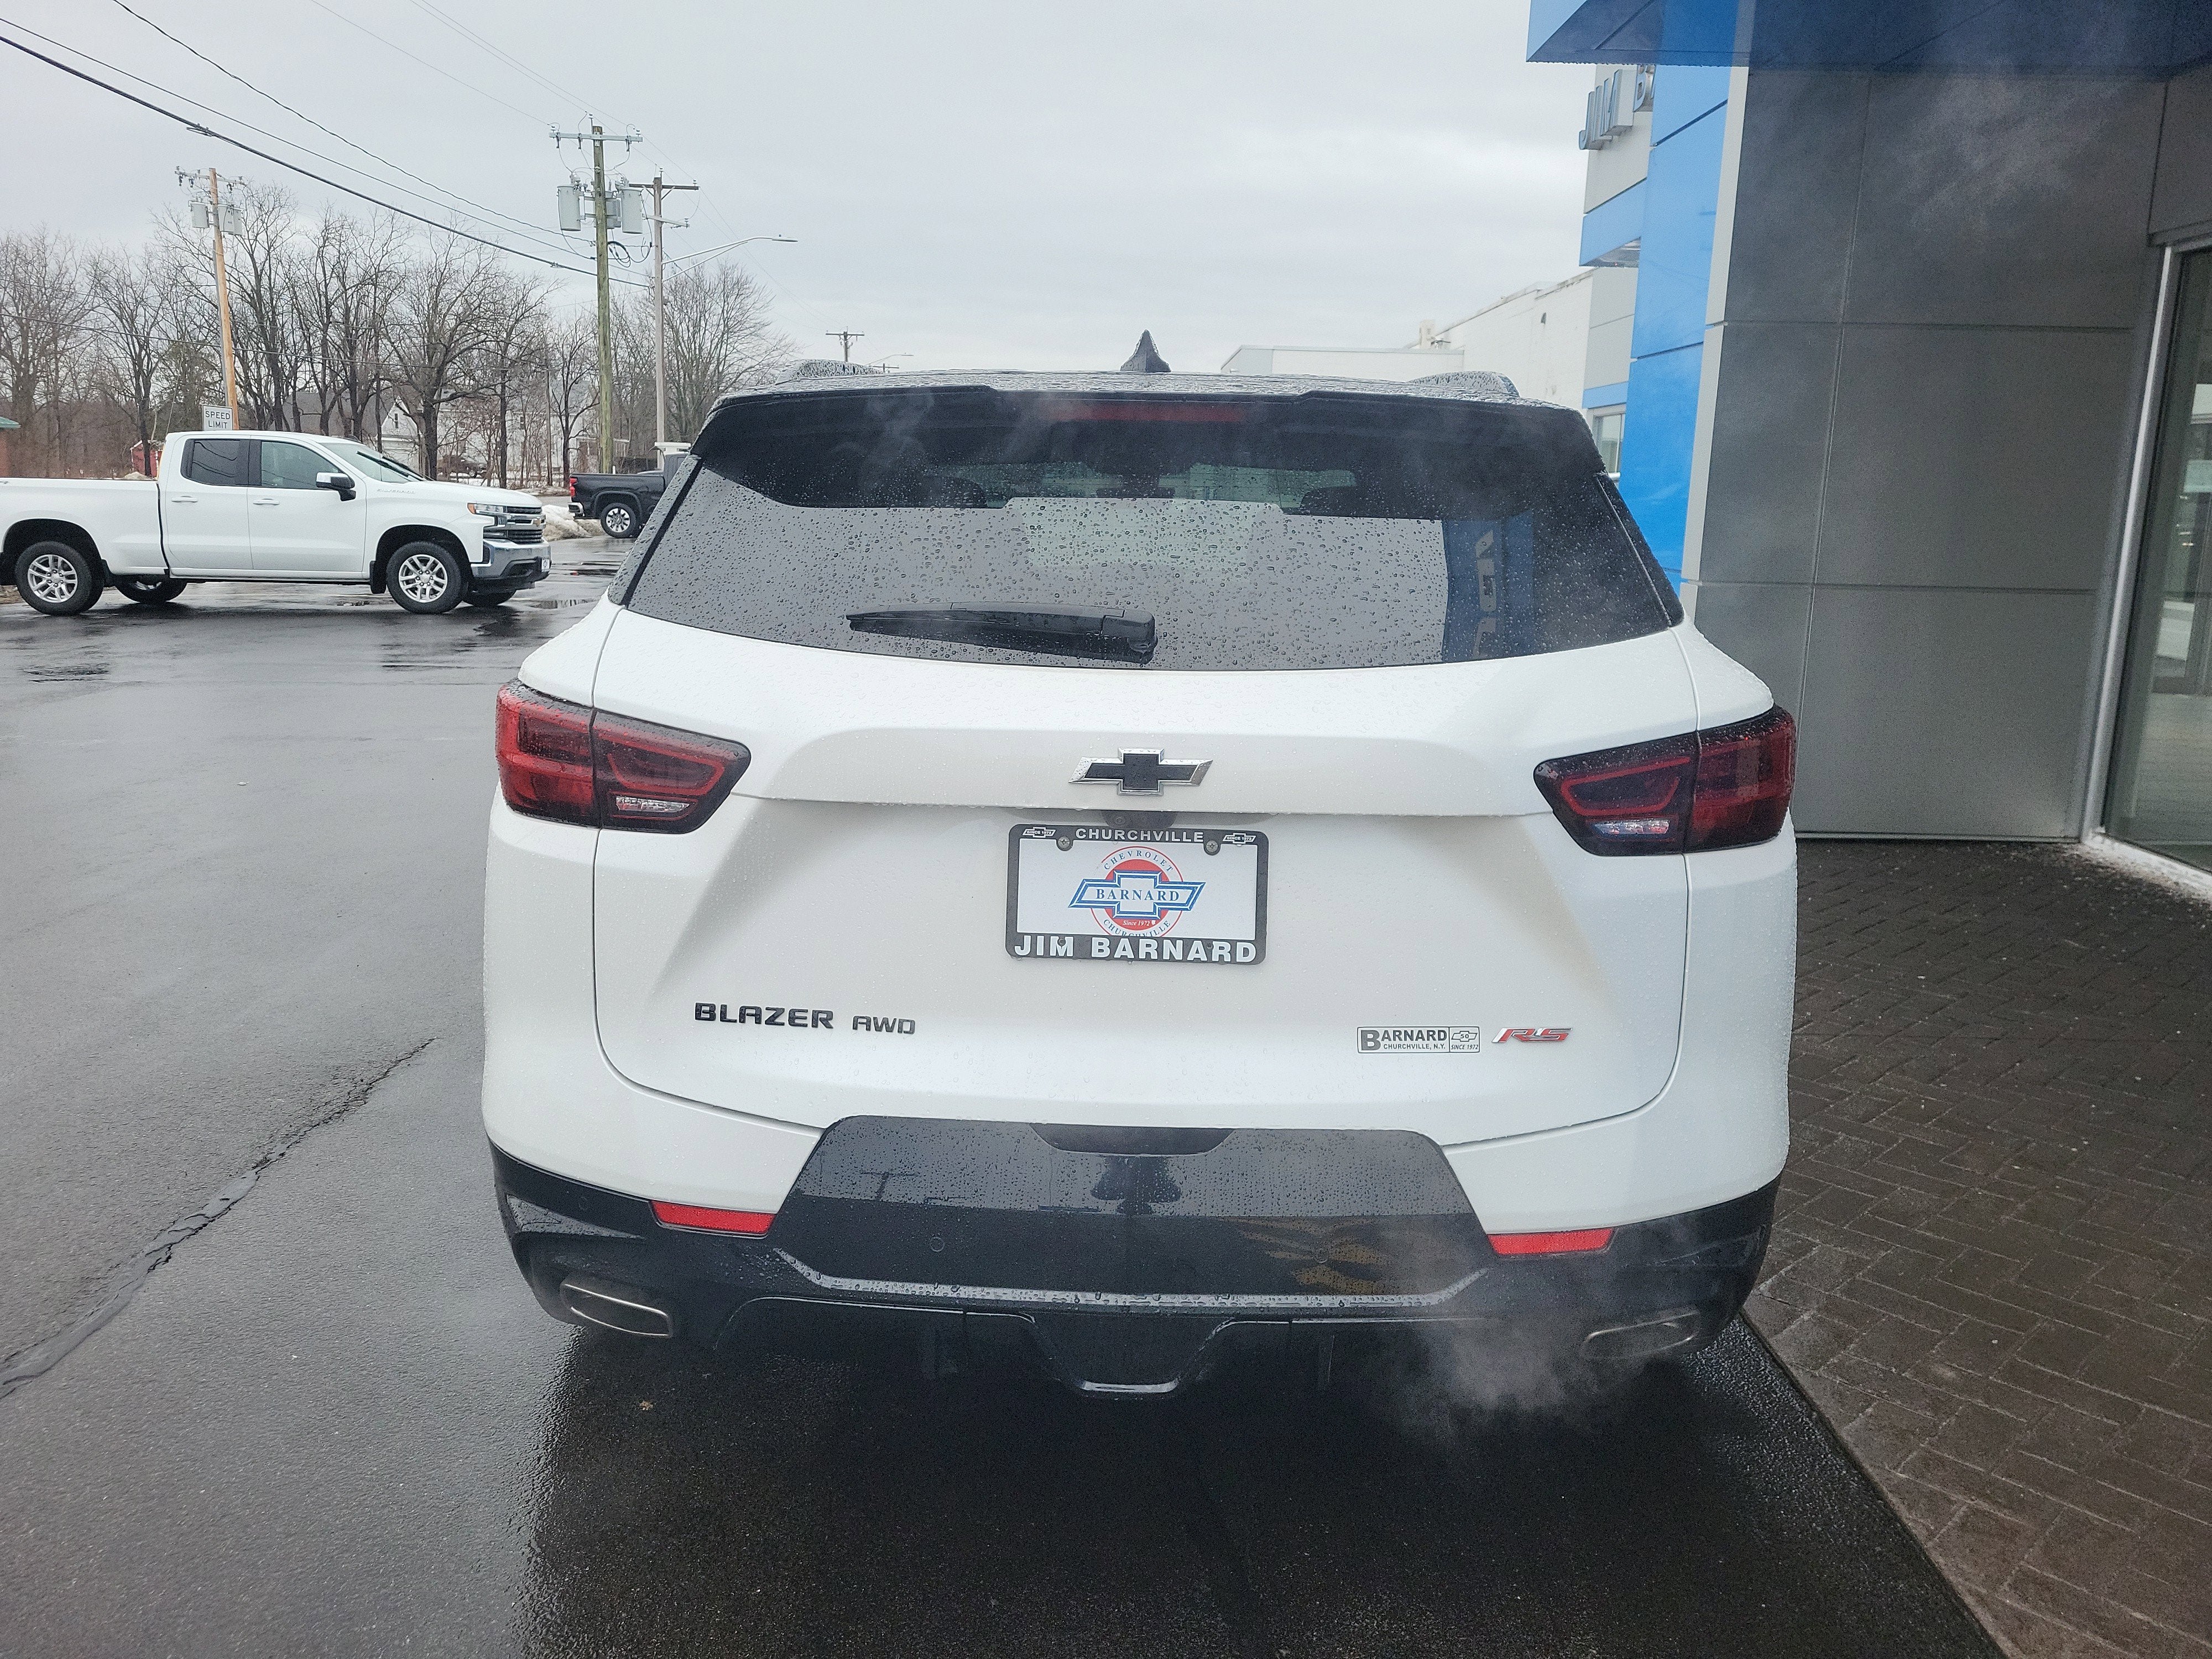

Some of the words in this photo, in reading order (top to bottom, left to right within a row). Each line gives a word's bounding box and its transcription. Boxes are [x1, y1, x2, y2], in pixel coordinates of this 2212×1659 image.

[205, 410, 231, 420] SPEED
[208, 420, 228, 429] LIMIT
[1076, 828, 1204, 842] CHURCHVILLE
[1104, 850, 1173, 872] CHEVROLET
[1095, 889, 1180, 901] BARNARD
[1014, 935, 1074, 957] JIM
[1091, 937, 1256, 963] BARNARD
[695, 1002, 834, 1029] BLAZER
[852, 1015, 916, 1035] AWD
[1361, 1029, 1447, 1051] BARNARD
[1491, 1027, 1573, 1044] RS
